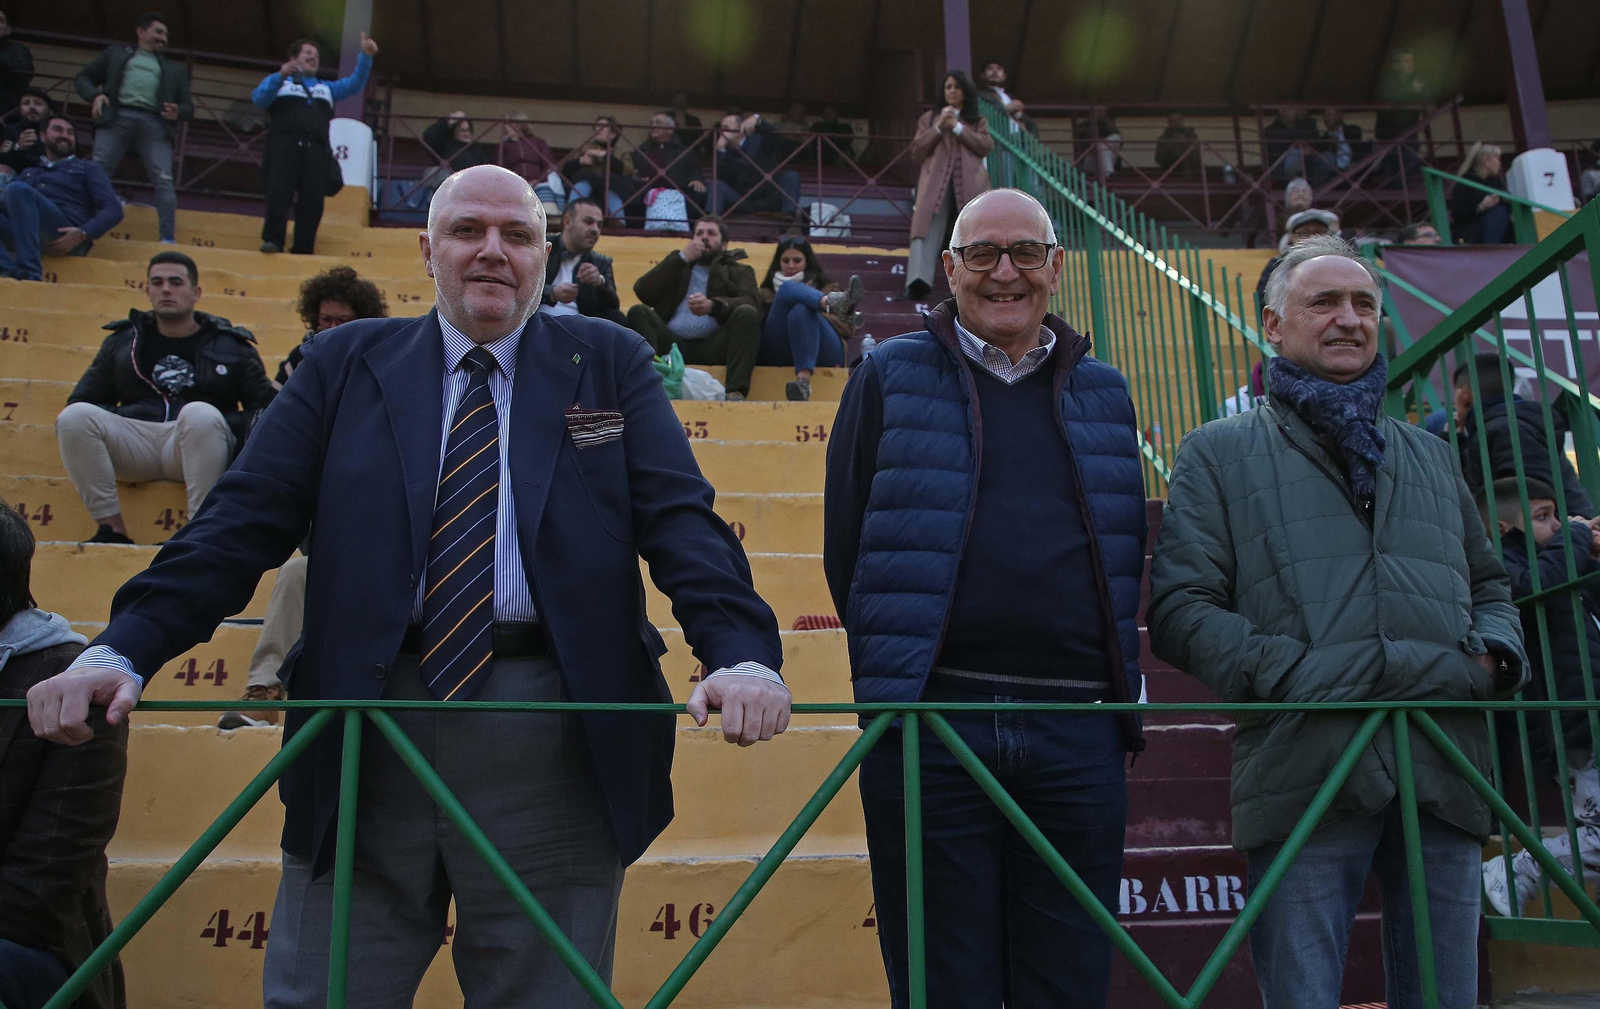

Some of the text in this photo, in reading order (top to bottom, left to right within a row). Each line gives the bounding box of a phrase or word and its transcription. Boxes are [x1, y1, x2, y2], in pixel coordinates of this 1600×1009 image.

[336, 145, 349, 160] 8
[1543, 172, 1555, 187] 7
[796, 424, 827, 442] 54
[173, 658, 229, 687] 44
[1118, 875, 1245, 915] BARR
[200, 908, 270, 950] 44
[649, 902, 716, 940] 46
